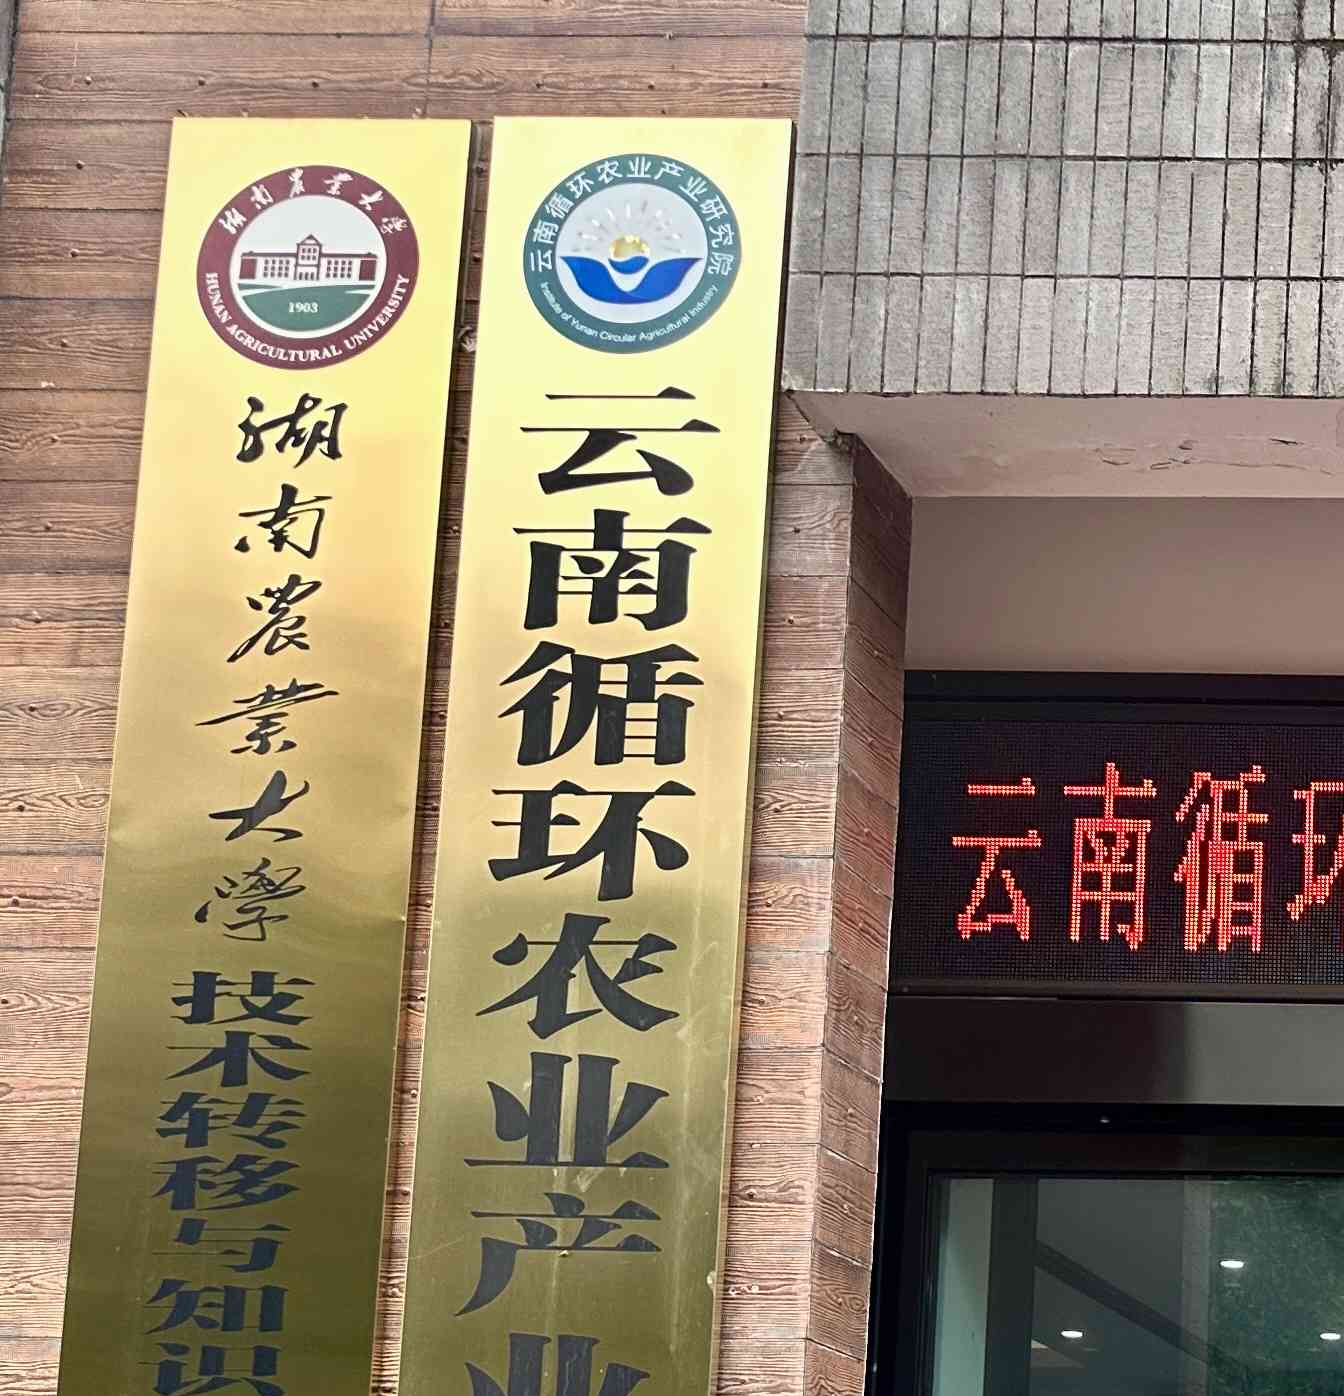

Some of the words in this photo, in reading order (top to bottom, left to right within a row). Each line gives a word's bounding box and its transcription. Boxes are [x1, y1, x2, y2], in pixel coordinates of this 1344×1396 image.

[530, 156, 735, 276] 云南循环农业产业研究院
[205, 272, 232, 323] HUNAN
[226, 324, 342, 362] AGRICULTURAL
[343, 274, 410, 350] UNIVERSITY
[288, 302, 318, 313] 1903
[561, 313, 573, 321] of
[599, 331, 636, 342] Circular
[640, 313, 690, 341] Agricultural
[688, 284, 719, 317] Industry
